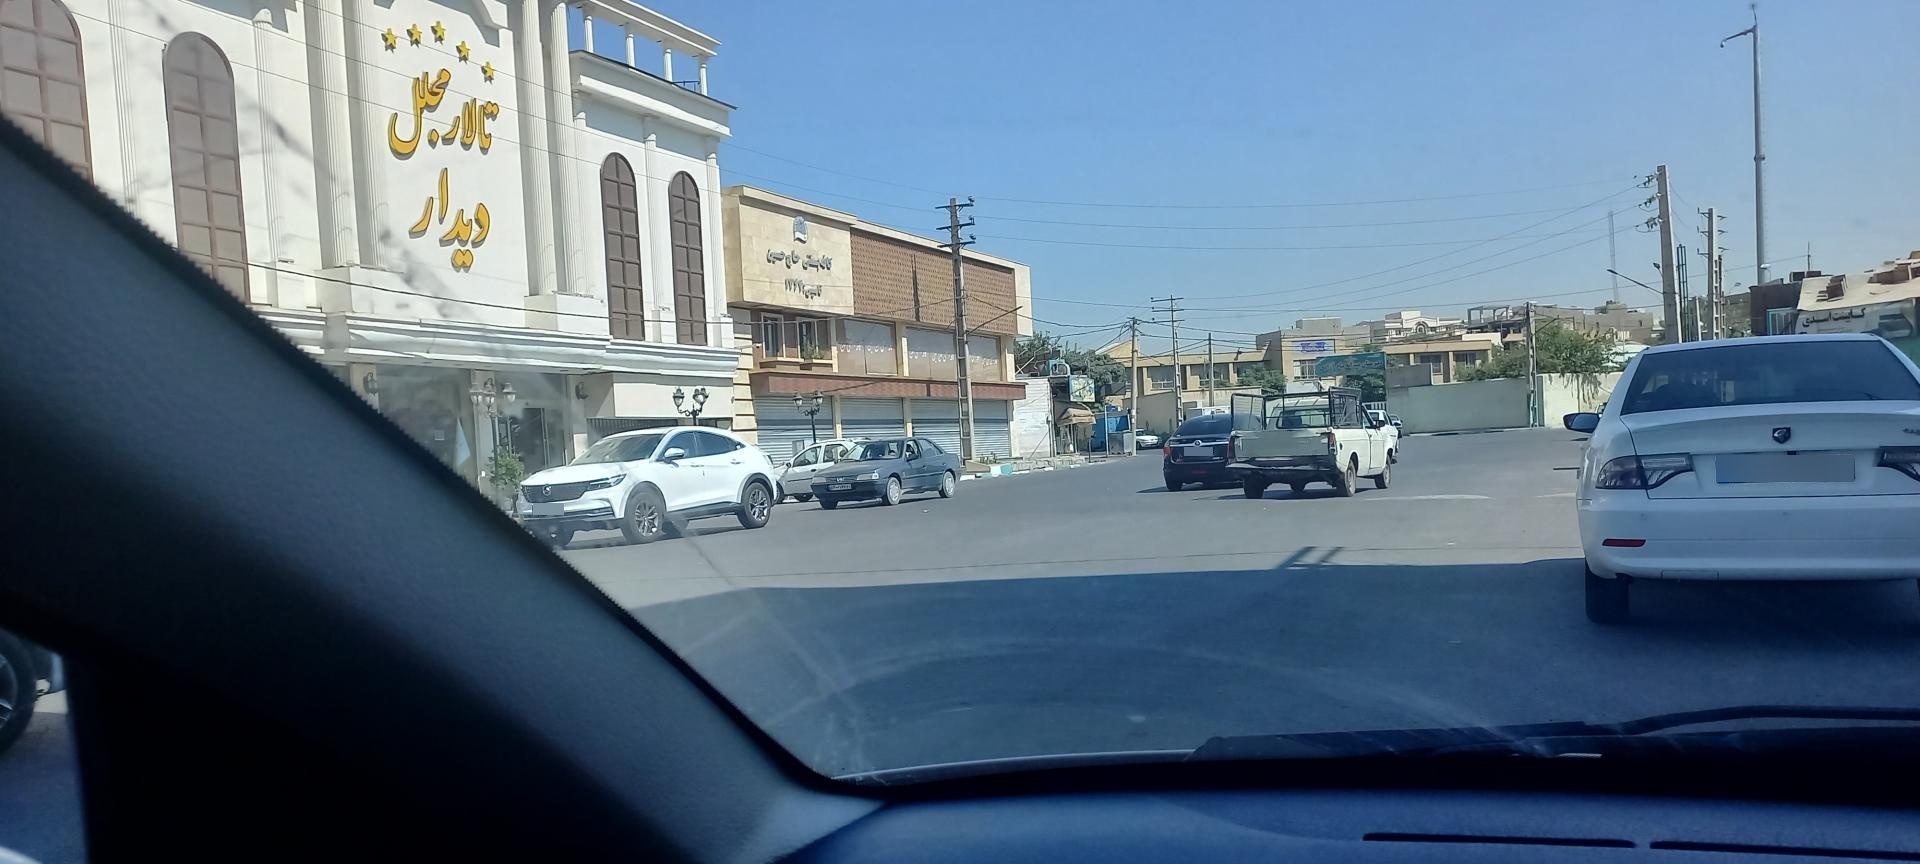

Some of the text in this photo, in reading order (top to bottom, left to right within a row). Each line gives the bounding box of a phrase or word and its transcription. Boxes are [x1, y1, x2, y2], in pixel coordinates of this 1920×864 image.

[388, 68, 500, 157] تالار مجلل
[409, 168, 490, 271] دیدار
[767, 248, 785, 264] حسین
[785, 250, 800, 269] حاج
[1802, 307, 1866, 327] کابینت اسدی
